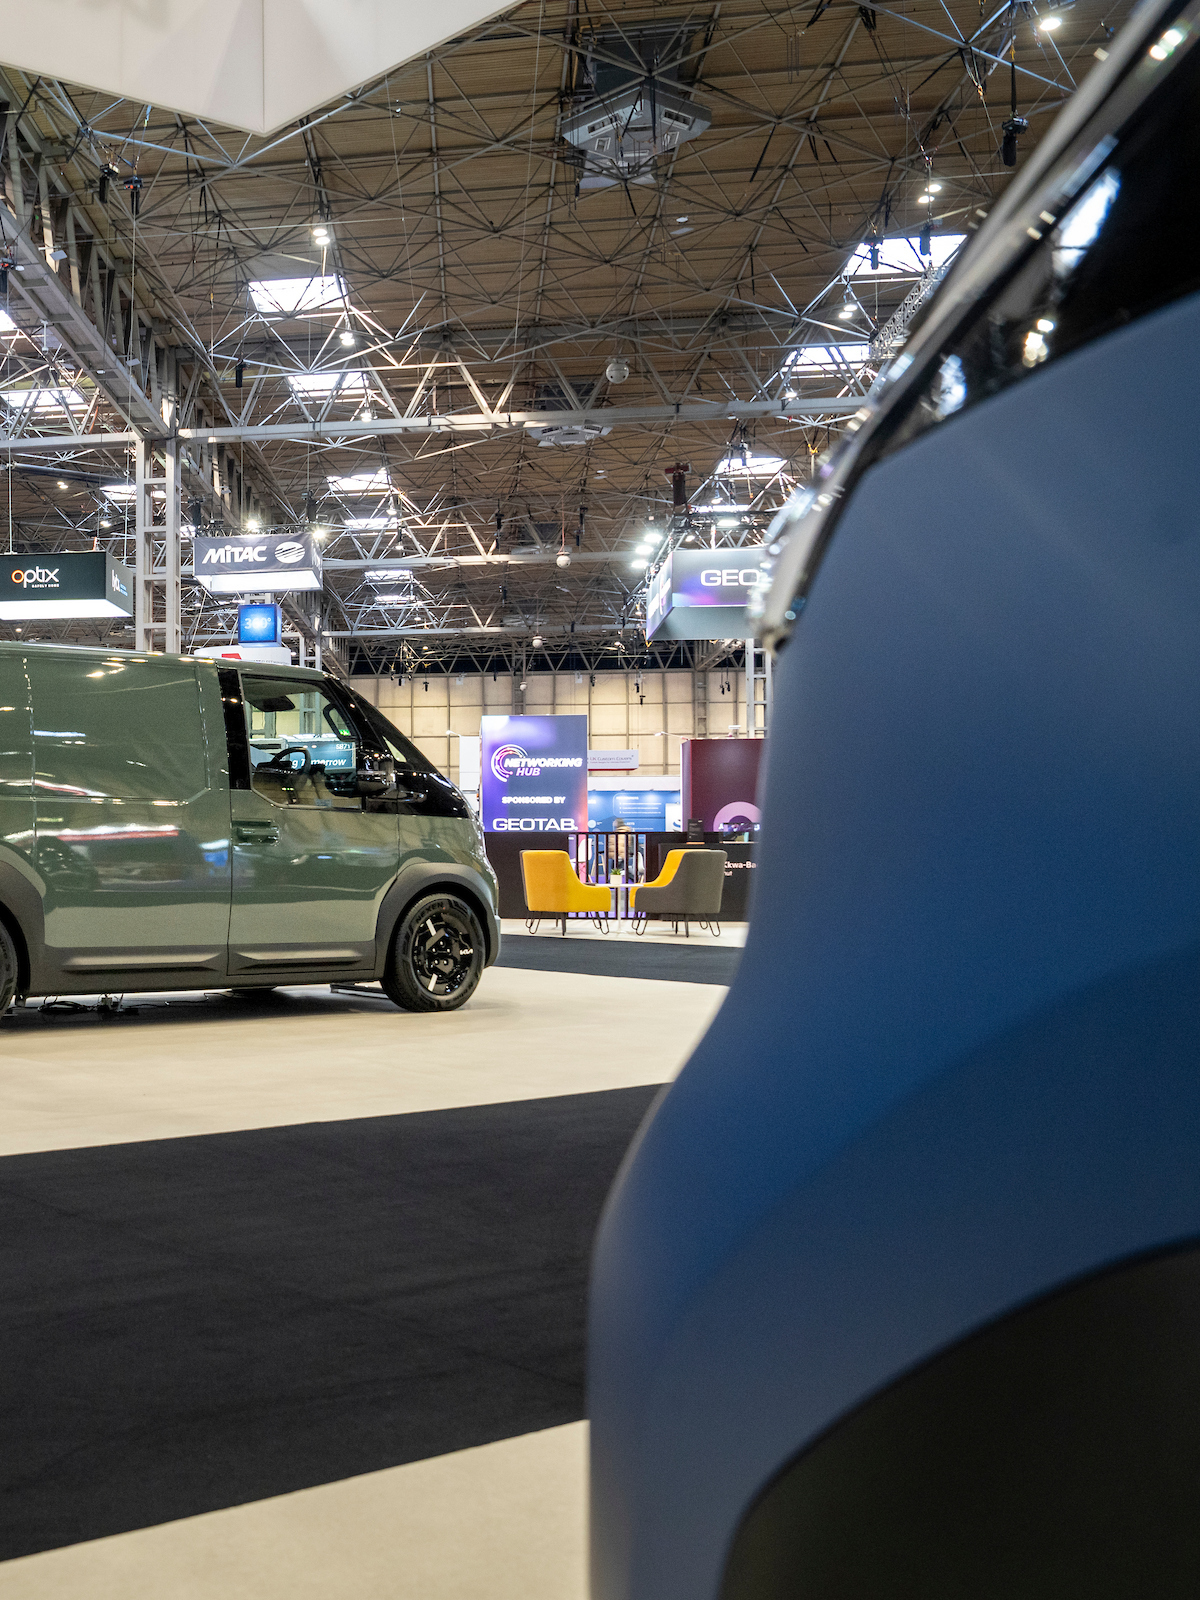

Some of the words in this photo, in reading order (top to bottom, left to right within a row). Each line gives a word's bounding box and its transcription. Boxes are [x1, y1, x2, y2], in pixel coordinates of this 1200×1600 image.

[11, 566, 59, 588] optix
[700, 569, 760, 586] GEO
[504, 758, 583, 767] NETWORKING
[516, 767, 540, 776] HUB
[501, 796, 553, 804] SPONSORED
[553, 796, 566, 804] BY
